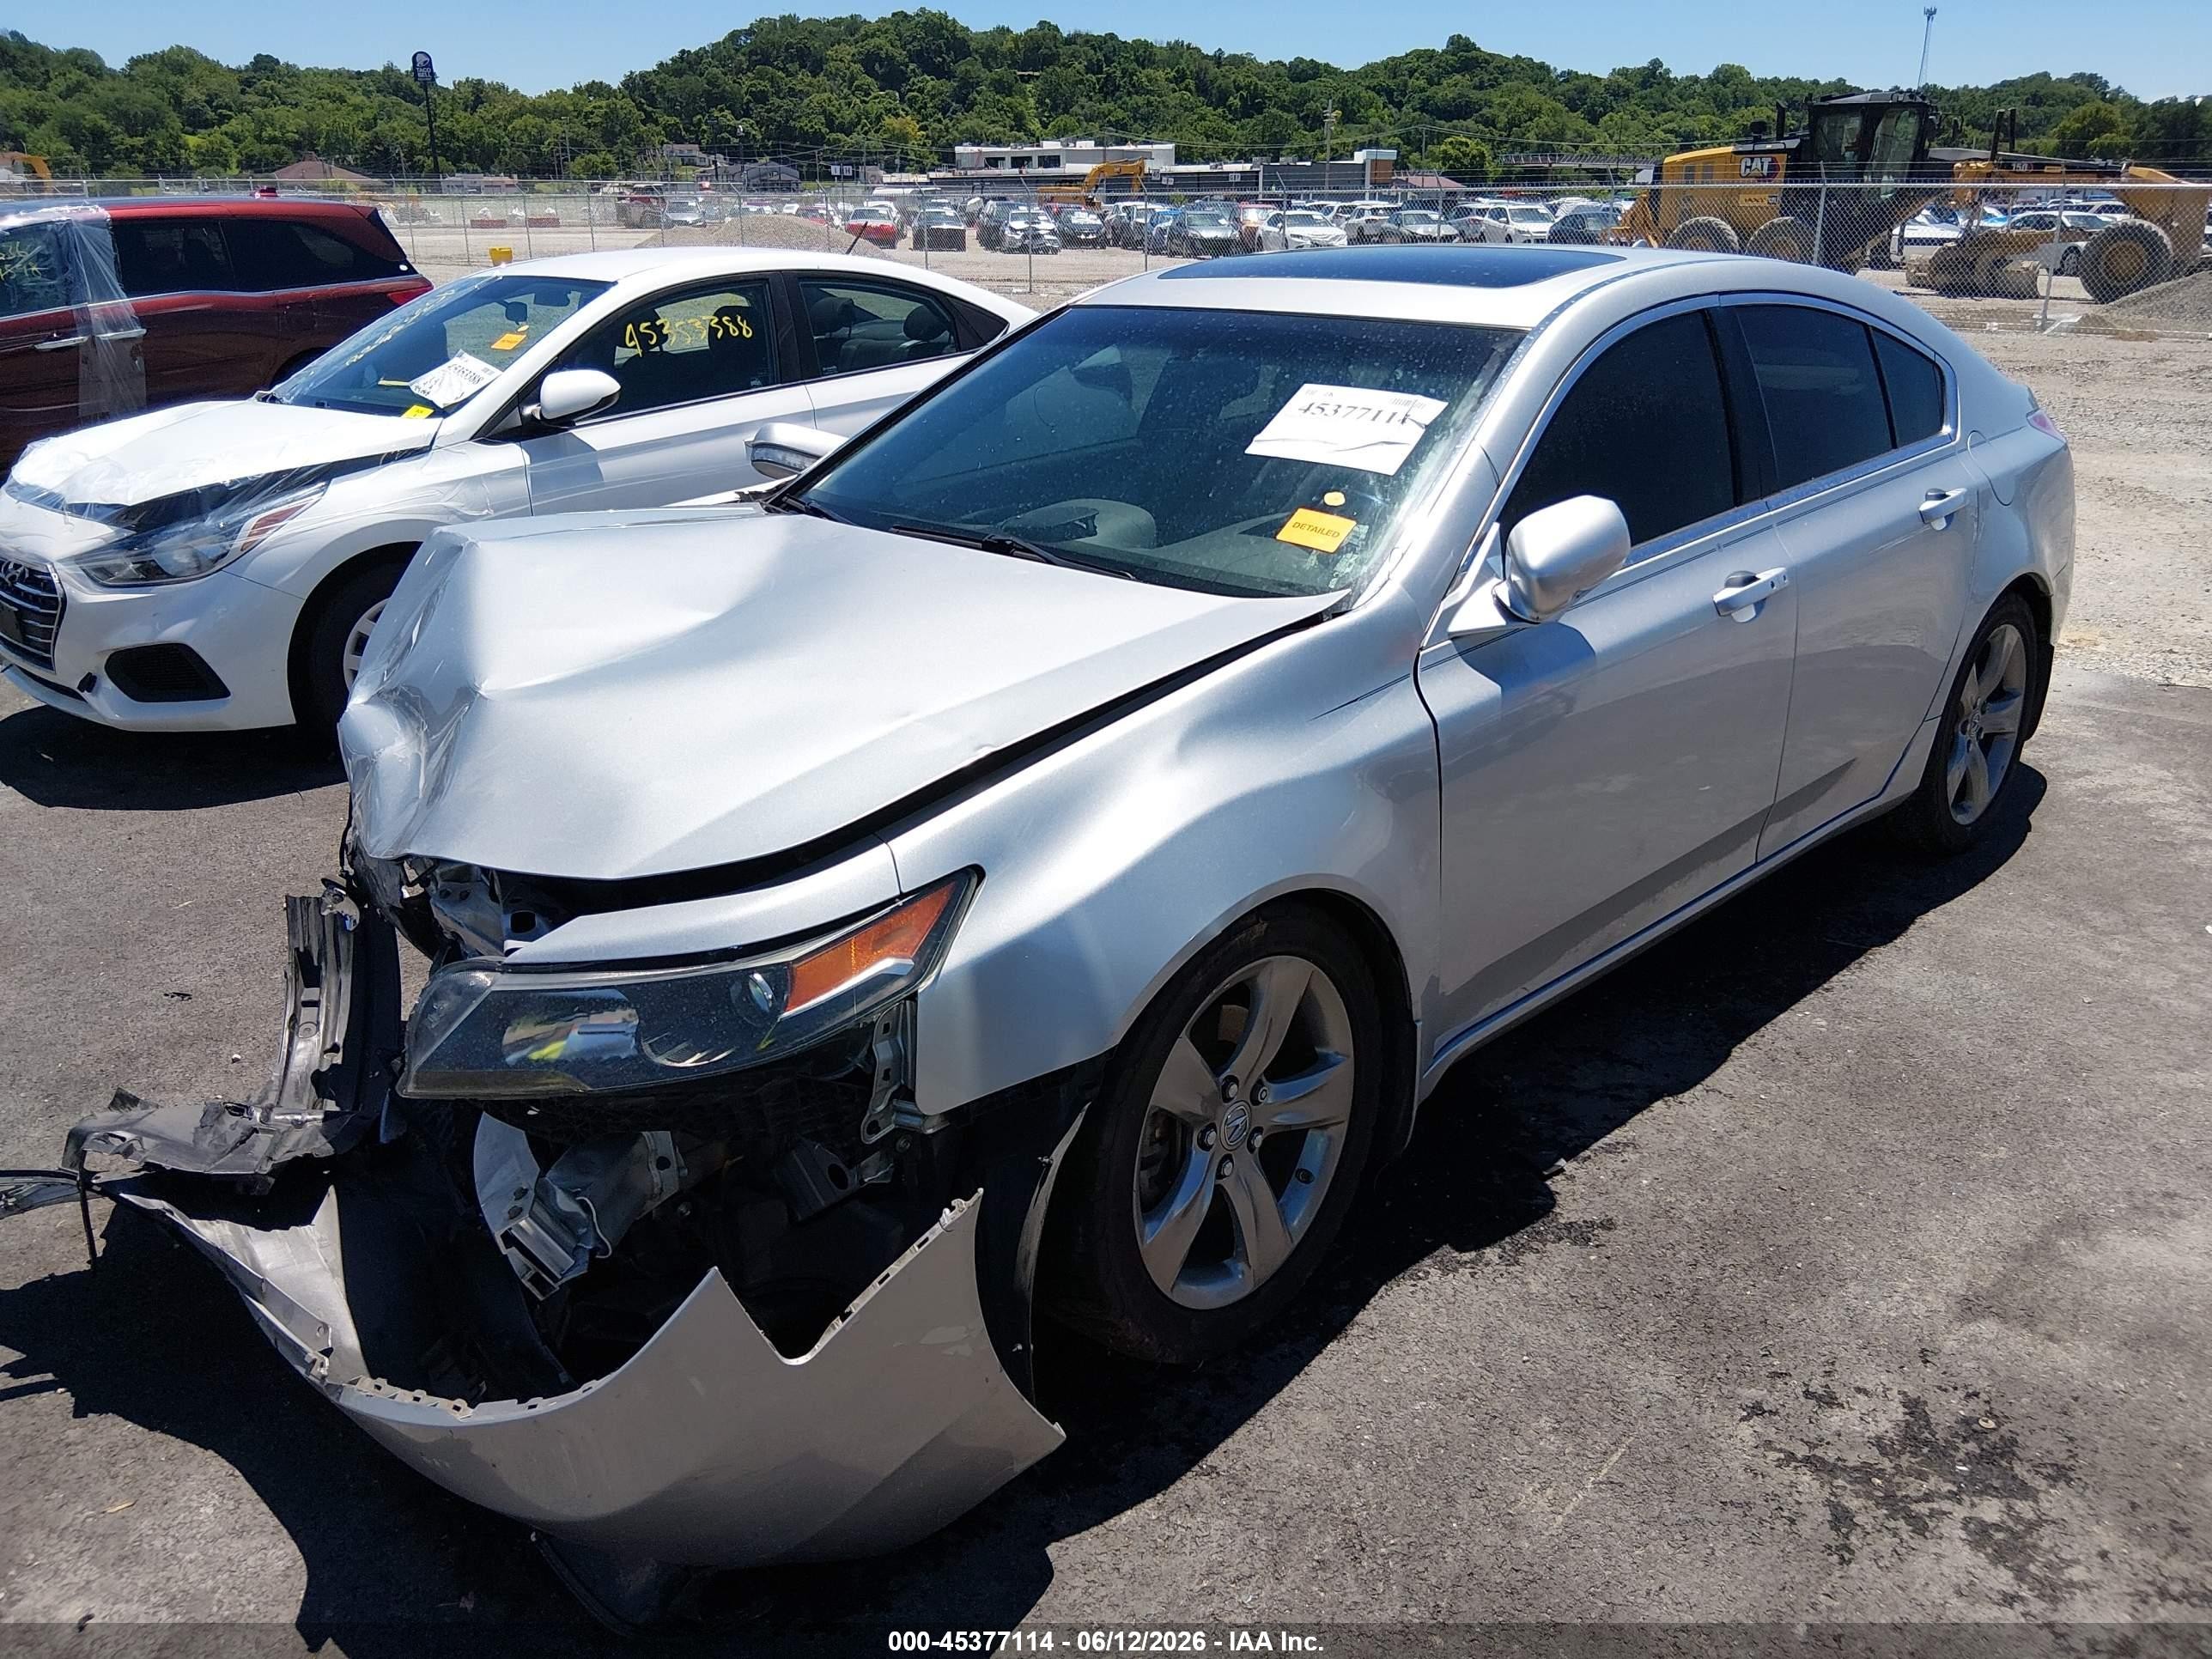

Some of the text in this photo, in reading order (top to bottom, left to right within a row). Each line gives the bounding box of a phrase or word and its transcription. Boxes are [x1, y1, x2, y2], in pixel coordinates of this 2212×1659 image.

[1741, 157, 1771, 177] CAT
[2011, 163, 2027, 172] 150
[1297, 401, 1411, 425] 45377114
[1292, 520, 1340, 539] DETAILED
